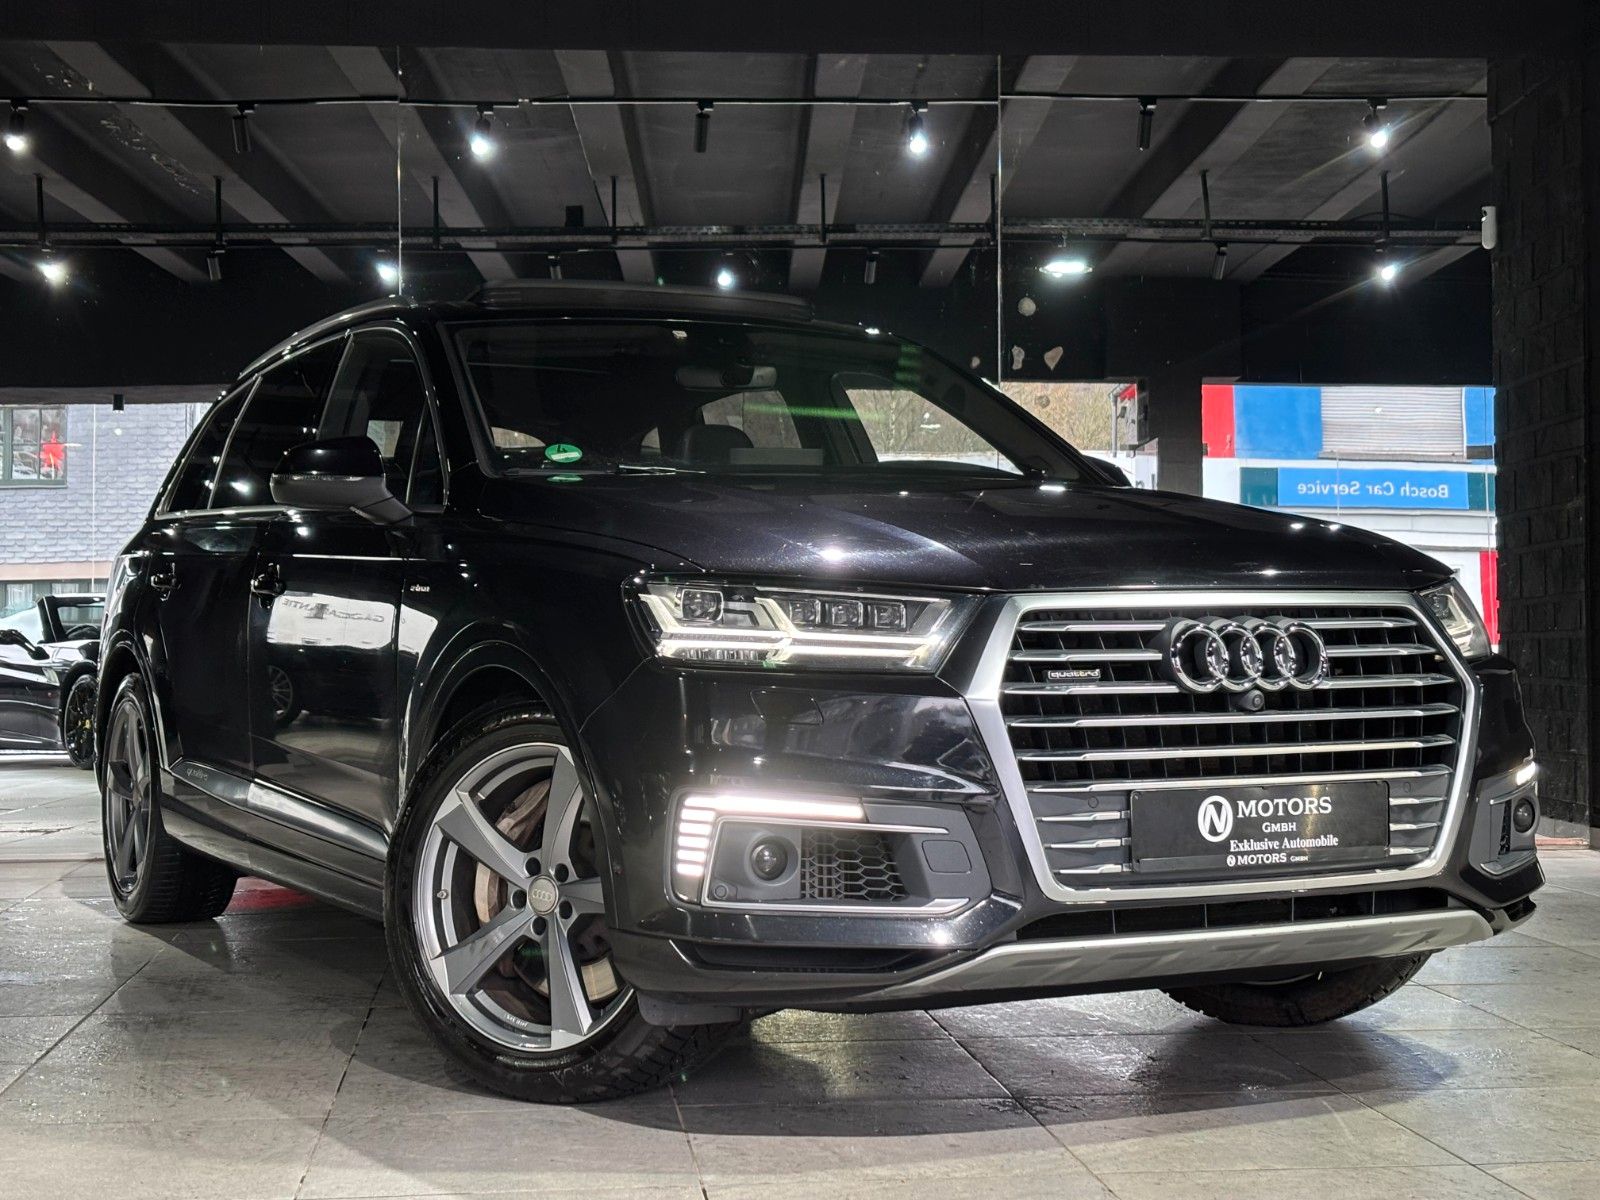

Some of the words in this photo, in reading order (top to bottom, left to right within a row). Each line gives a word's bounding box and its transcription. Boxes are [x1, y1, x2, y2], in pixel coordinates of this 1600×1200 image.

[1050, 669, 1099, 678] quattro
[1236, 796, 1332, 818] MOTORS
[1230, 838, 1280, 852] Exklusive
[1282, 834, 1339, 849] Automobile
[1237, 852, 1287, 866] MOTORS
